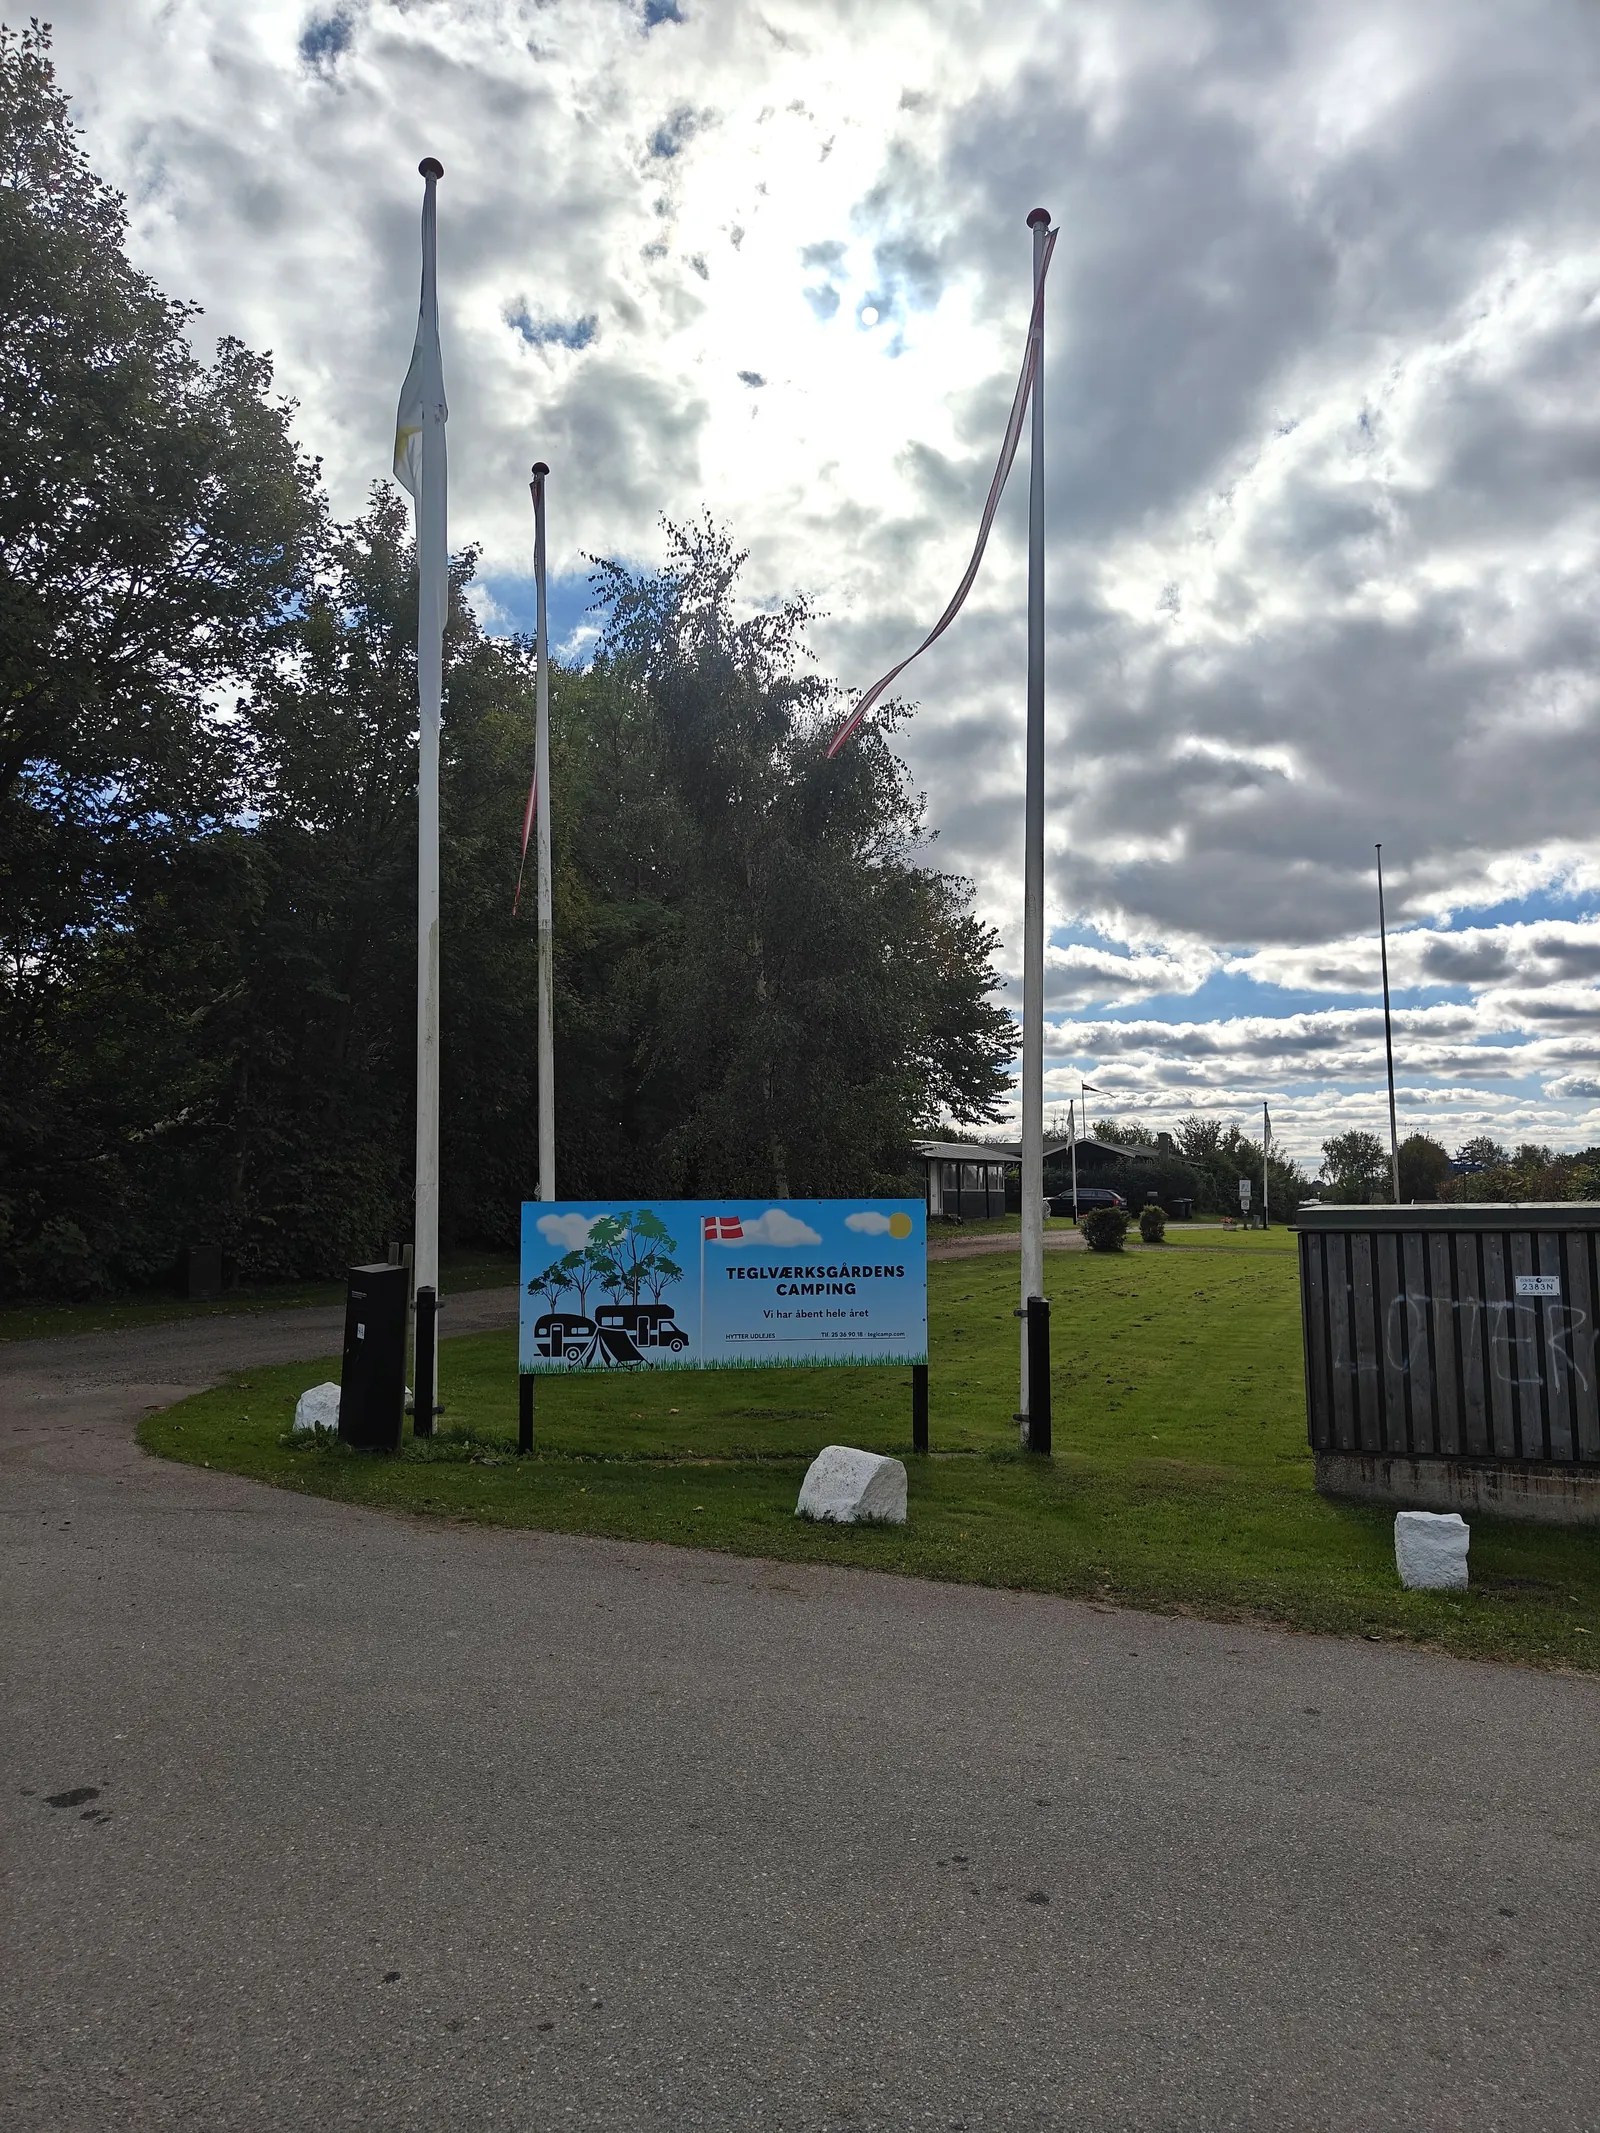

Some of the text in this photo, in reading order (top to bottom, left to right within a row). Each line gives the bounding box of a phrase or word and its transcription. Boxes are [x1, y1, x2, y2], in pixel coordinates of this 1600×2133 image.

[726, 1262, 905, 1280] TEGLVÆRKSGÅRDENS
[776, 1283, 856, 1296] CAMPING
[1522, 1283, 1553, 1291] 2383N
[763, 1309, 869, 1318] Vi har åbent hele året
